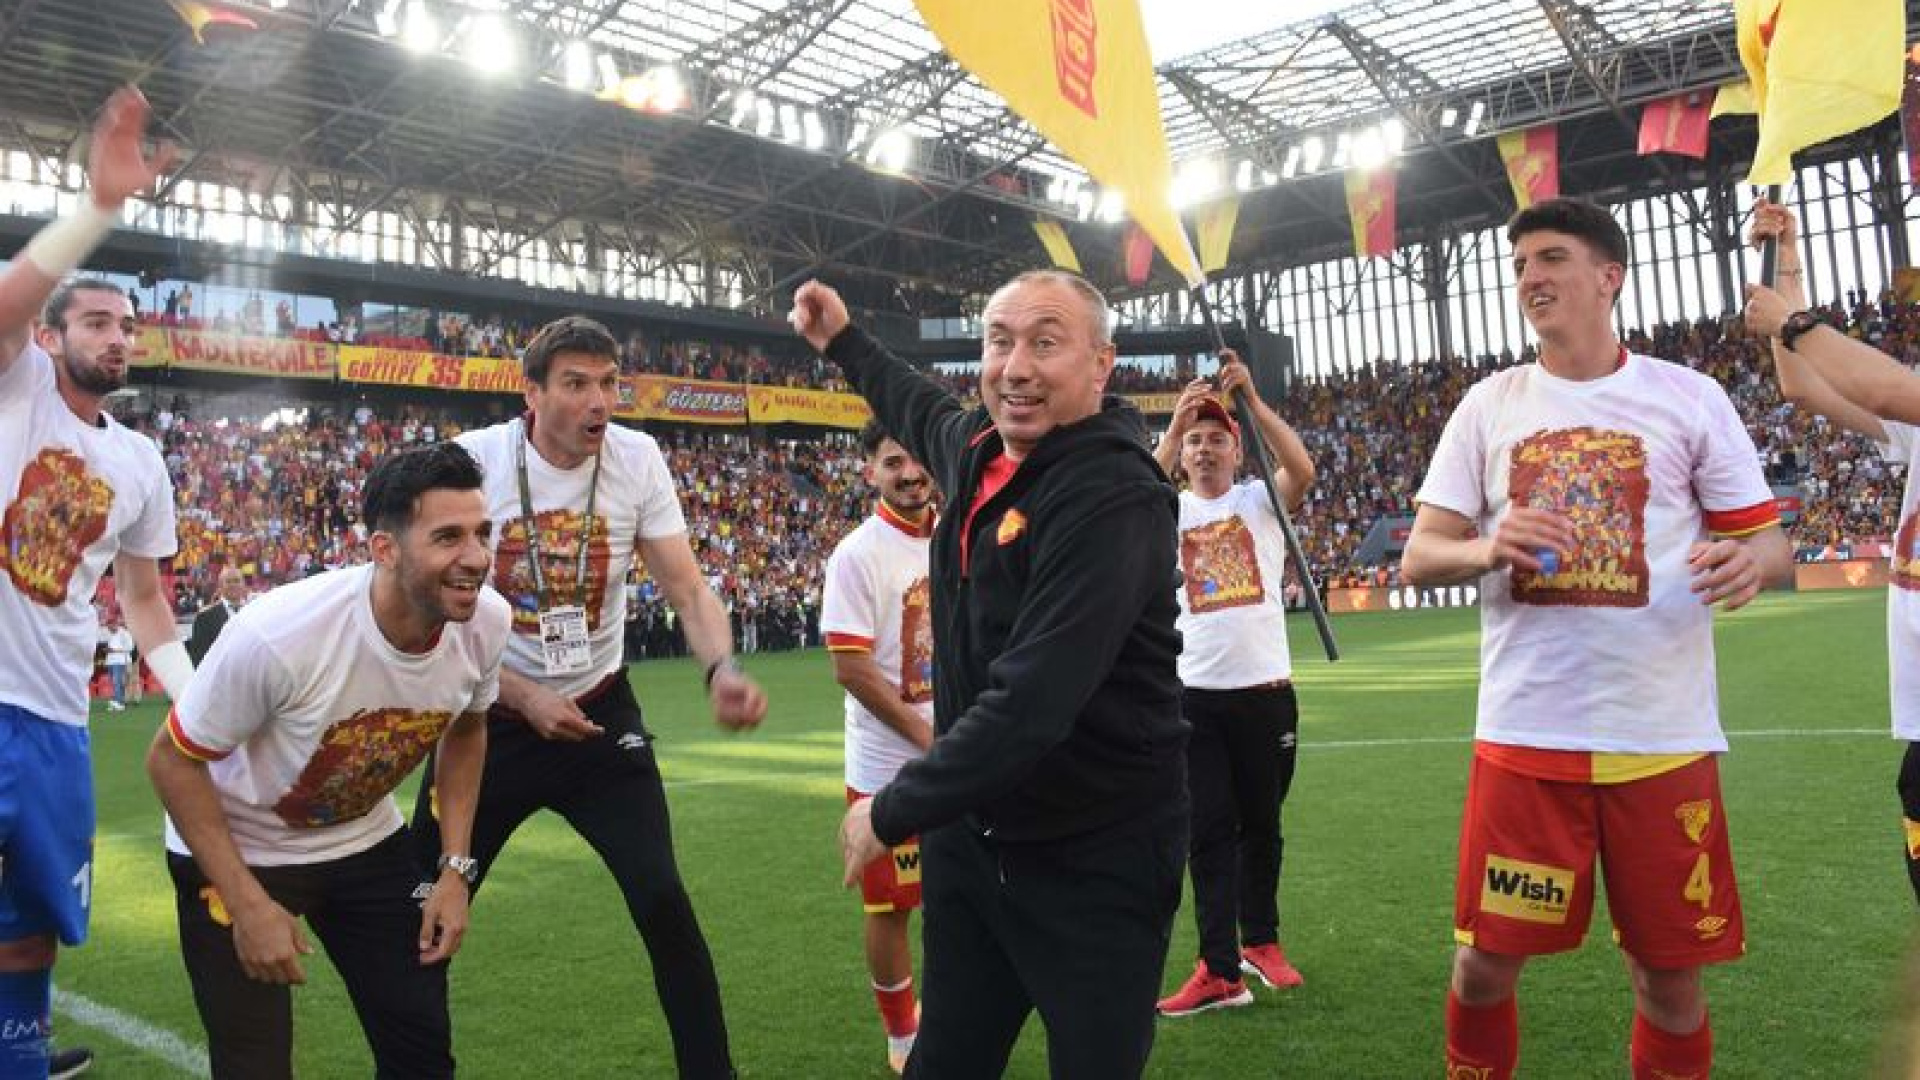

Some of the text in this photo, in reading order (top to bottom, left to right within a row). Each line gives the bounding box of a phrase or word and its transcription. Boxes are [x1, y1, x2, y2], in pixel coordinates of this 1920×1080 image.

[428, 355, 464, 385] 35
[71, 861, 90, 908] 1
[1488, 867, 1563, 903] Wish
[1684, 851, 1712, 908] 4
